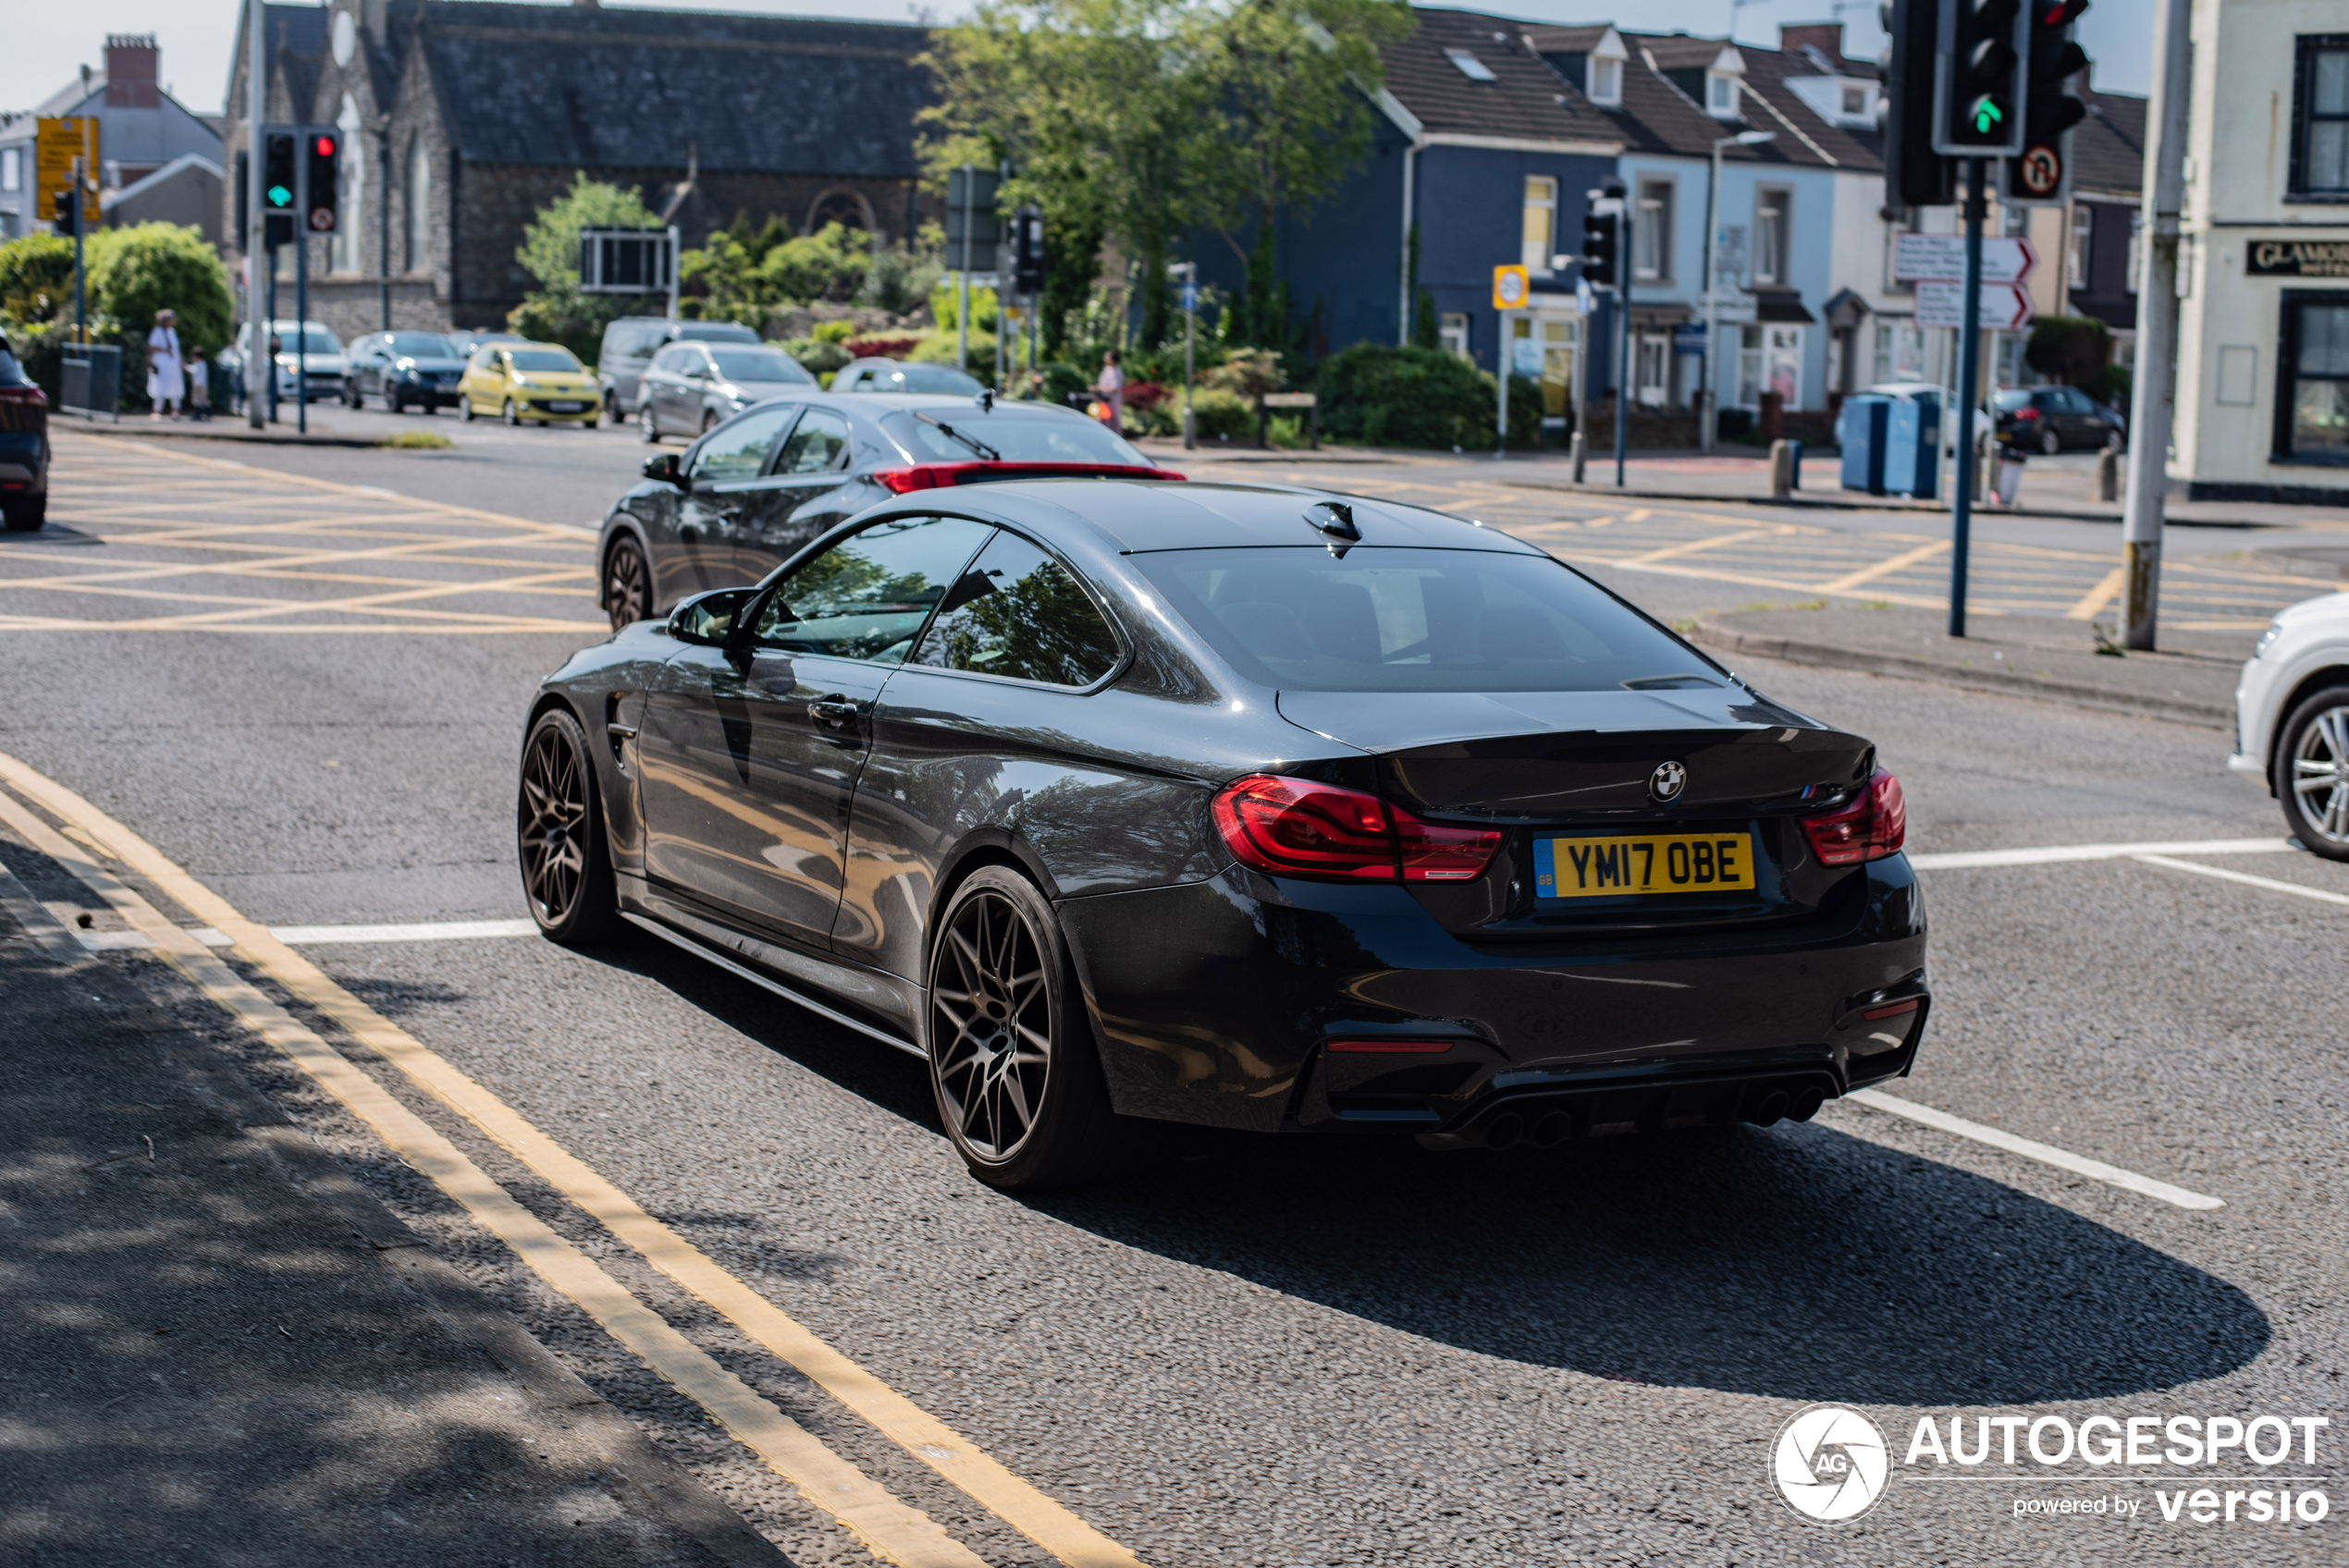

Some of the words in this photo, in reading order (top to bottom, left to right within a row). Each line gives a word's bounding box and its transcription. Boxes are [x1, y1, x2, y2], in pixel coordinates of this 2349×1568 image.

[1568, 842, 1654, 888] YM17
[1667, 840, 1740, 885] OBE
[1538, 874, 1553, 886] GB
